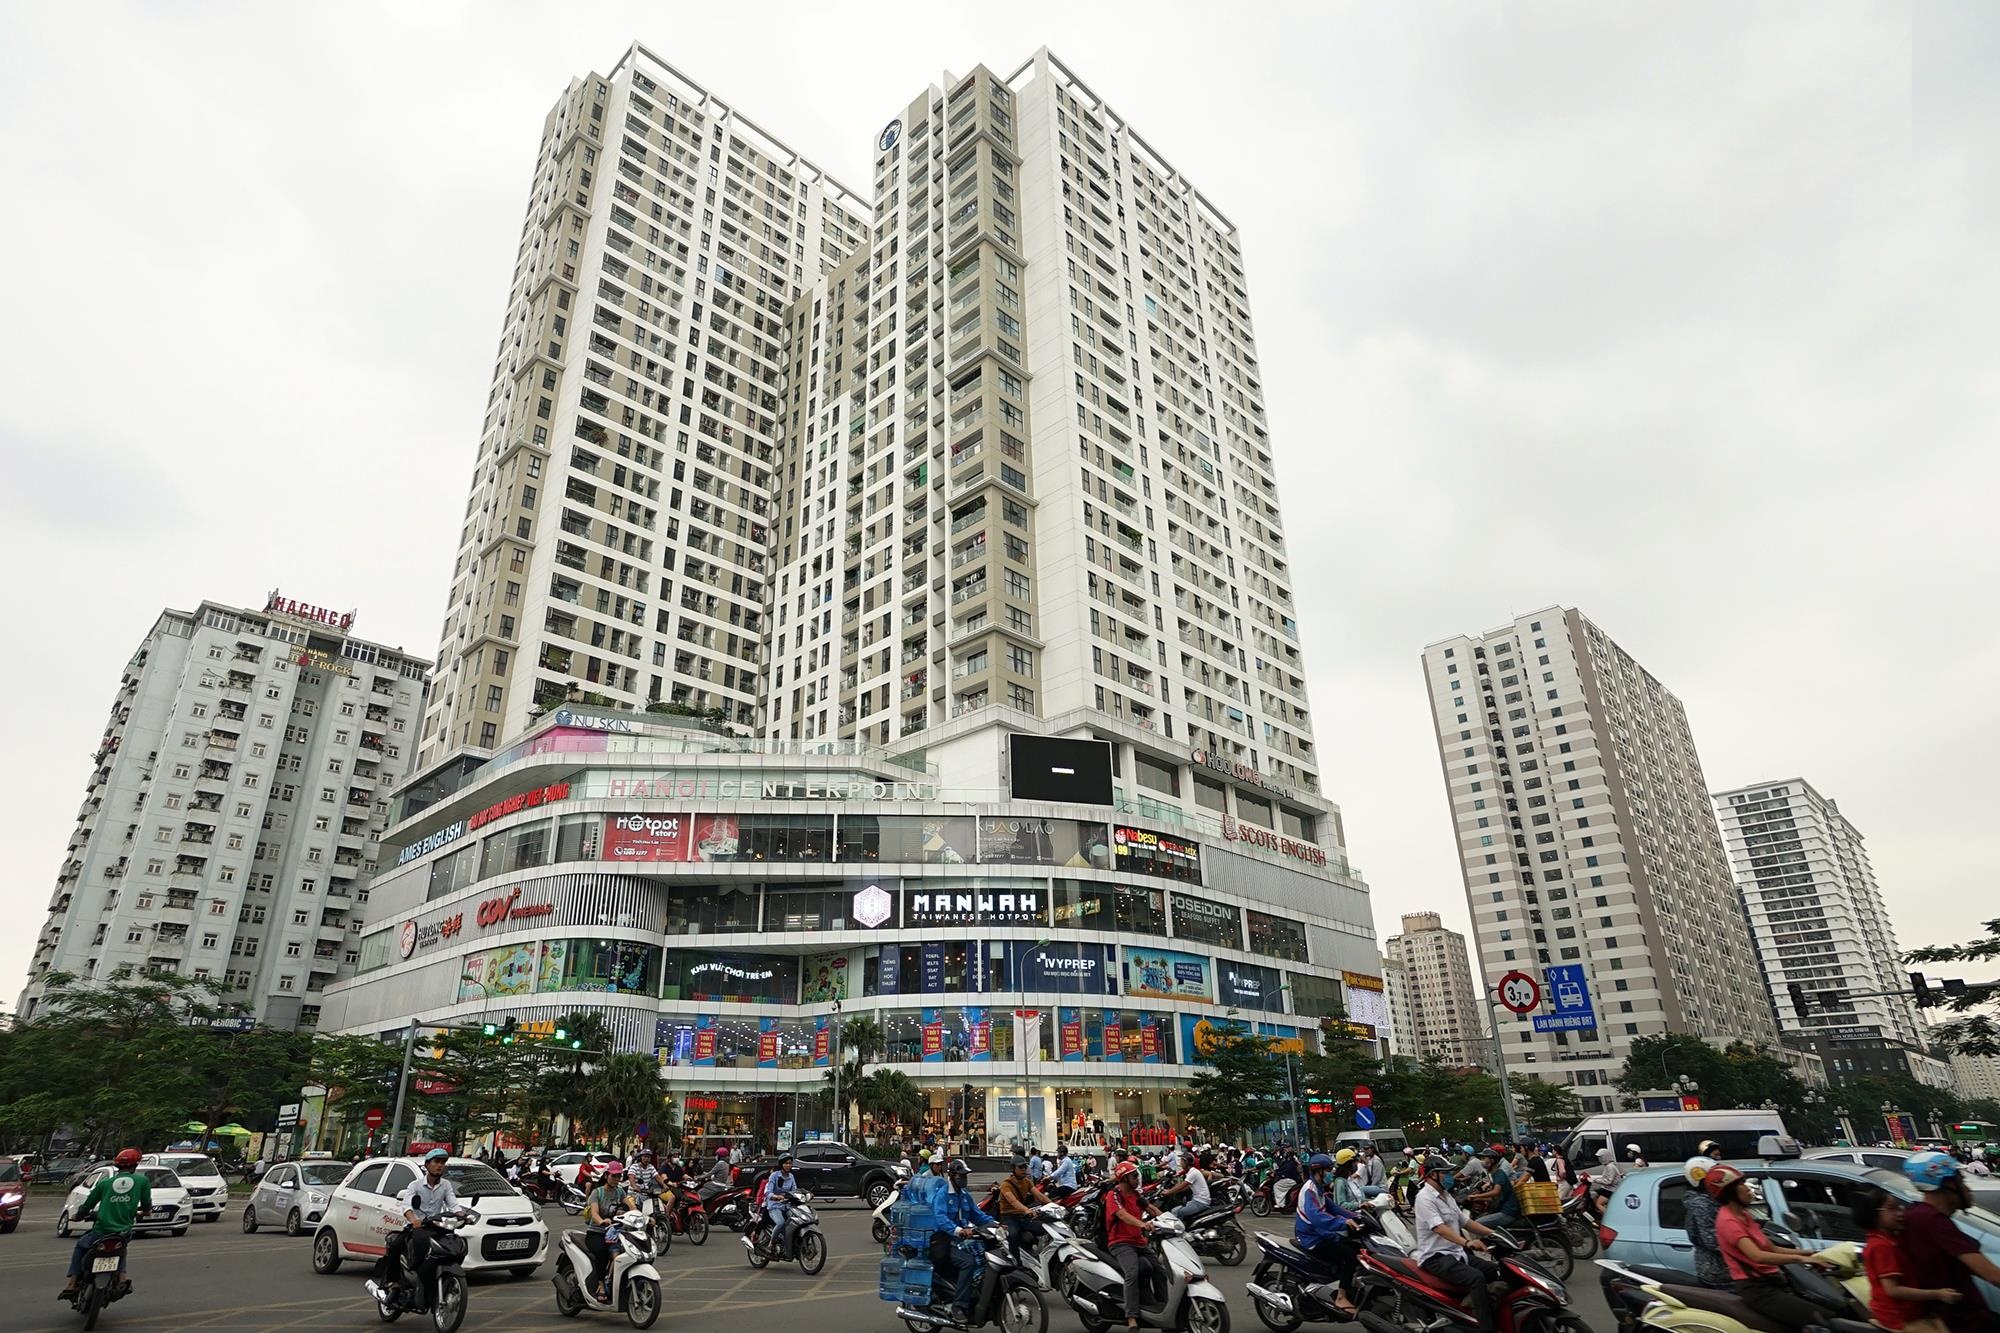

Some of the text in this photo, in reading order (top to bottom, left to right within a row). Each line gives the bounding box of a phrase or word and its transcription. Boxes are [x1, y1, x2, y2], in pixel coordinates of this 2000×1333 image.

[274, 596, 351, 629] HACINCO
[320, 661, 352, 675] ROCK
[574, 715, 595, 727] NU
[610, 779, 708, 798] HANOI
[398, 821, 464, 866] AMES ENGLISH
[1126, 829, 1157, 844] Nabesu
[1239, 824, 1327, 866] SCOTS ENGLISH
[476, 895, 553, 927] CGV CINEMAS
[914, 895, 1036, 912] MANWAH
[690, 964, 708, 975] KHU
[761, 970, 773, 978] EM
[1045, 958, 1096, 970] IVYPREP
[1581, 1016, 1592, 1025] BRT
[1132, 1127, 1176, 1145] CANIFA
[110, 1195, 131, 1203] Grab
